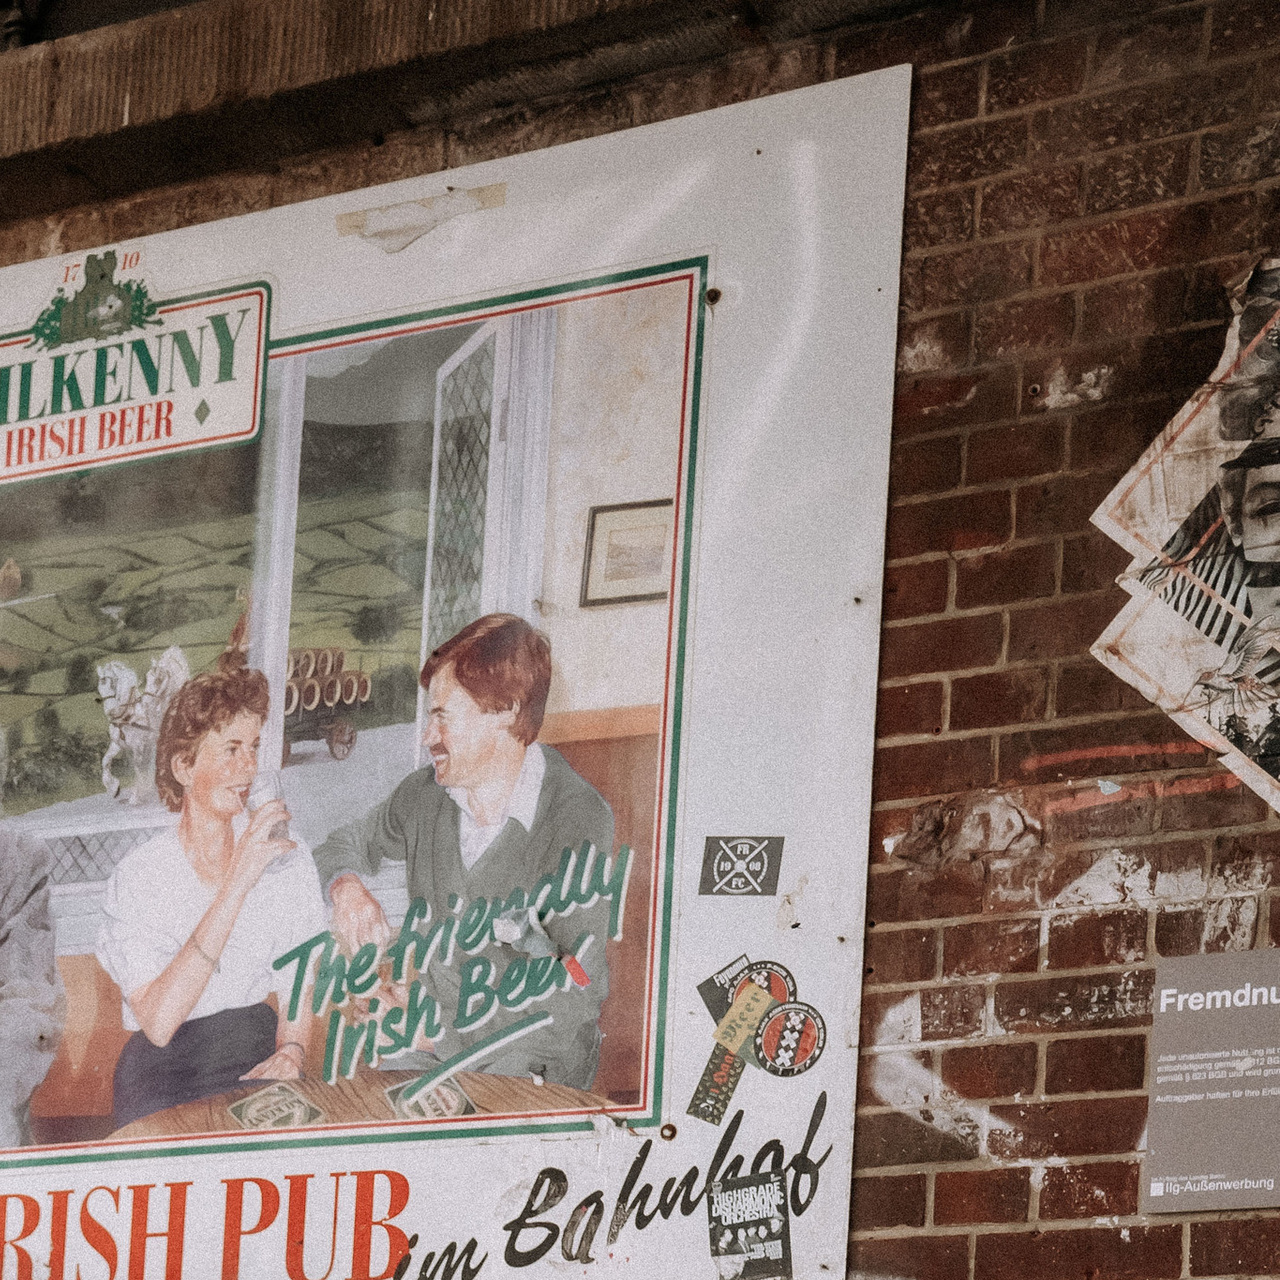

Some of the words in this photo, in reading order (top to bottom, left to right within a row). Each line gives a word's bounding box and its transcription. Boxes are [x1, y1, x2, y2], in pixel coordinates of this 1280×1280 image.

[63, 263, 81, 284] 17
[121, 251, 141, 271] 10
[4, 414, 88, 469] IRISH
[97, 399, 174, 451] BEER
[271, 930, 382, 1022] The
[322, 979, 445, 1086] Irish
[452, 933, 595, 1033] Beer
[503, 1089, 834, 1268] Bahnhof
